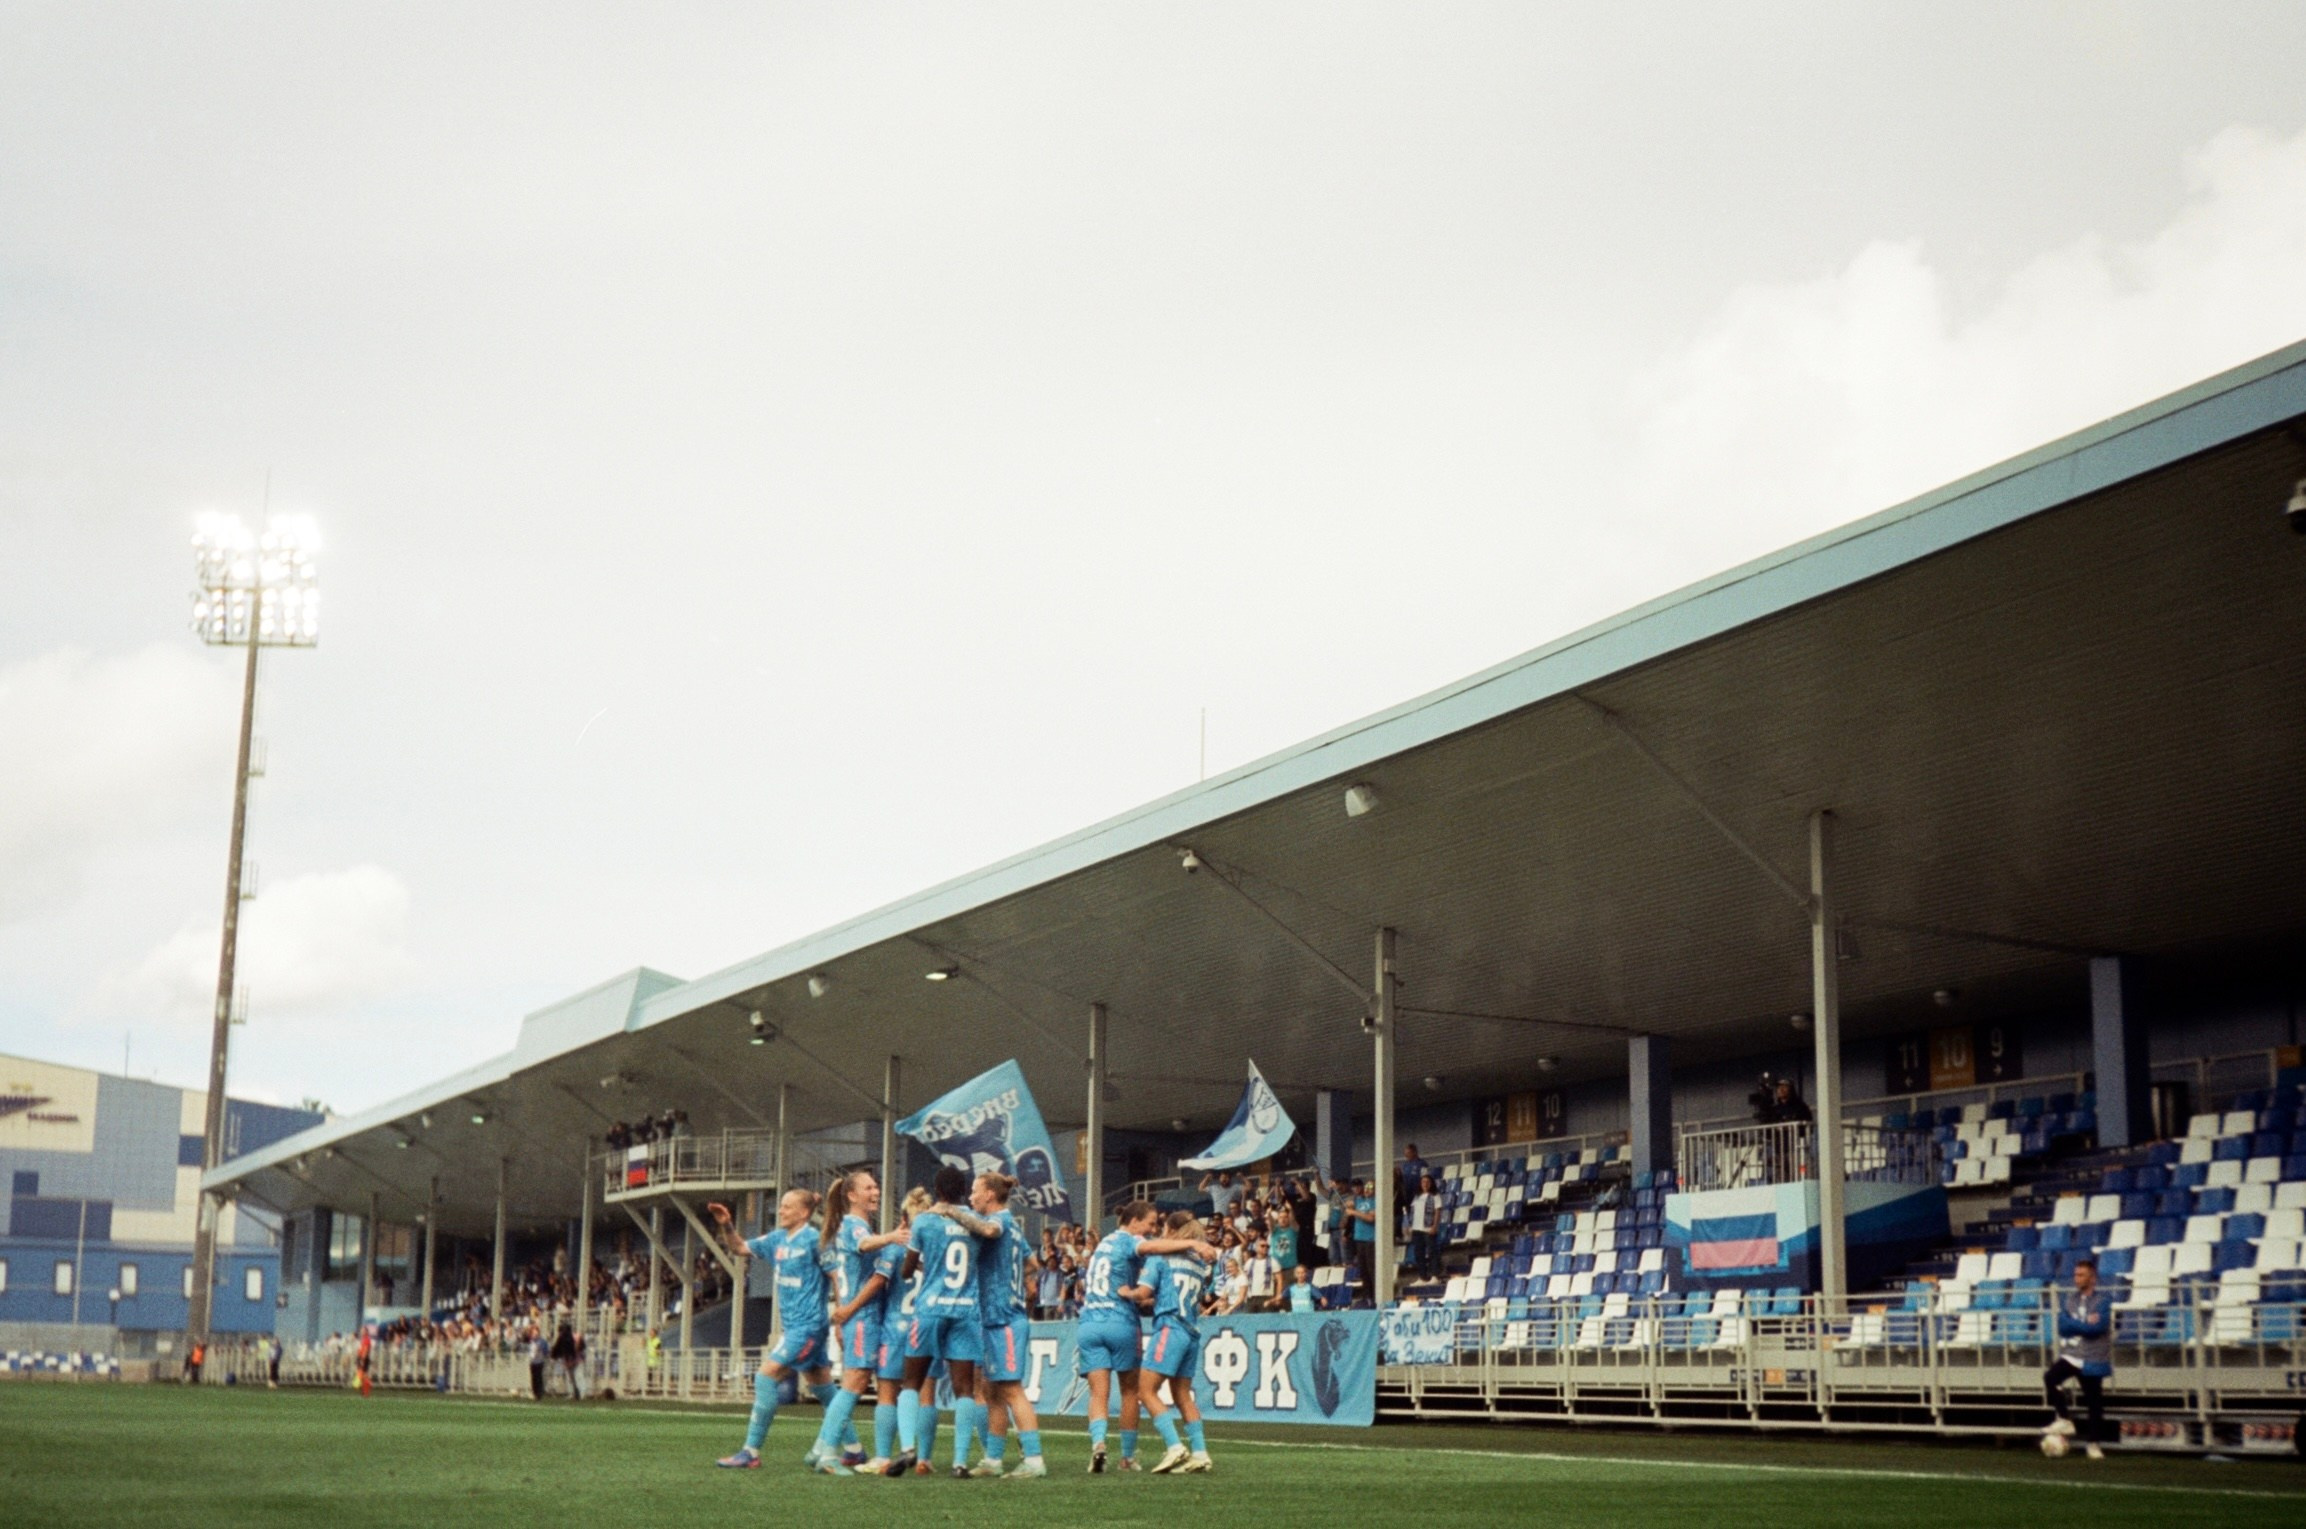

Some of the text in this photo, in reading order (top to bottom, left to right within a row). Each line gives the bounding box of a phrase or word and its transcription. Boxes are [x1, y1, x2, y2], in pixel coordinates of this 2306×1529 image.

[1937, 1034, 1967, 1069] 10
[1990, 1026, 2005, 1059] 9
[1543, 1093, 1560, 1119] 10
[944, 1241, 969, 1289] 9
[1422, 1308, 1453, 1334] 100
